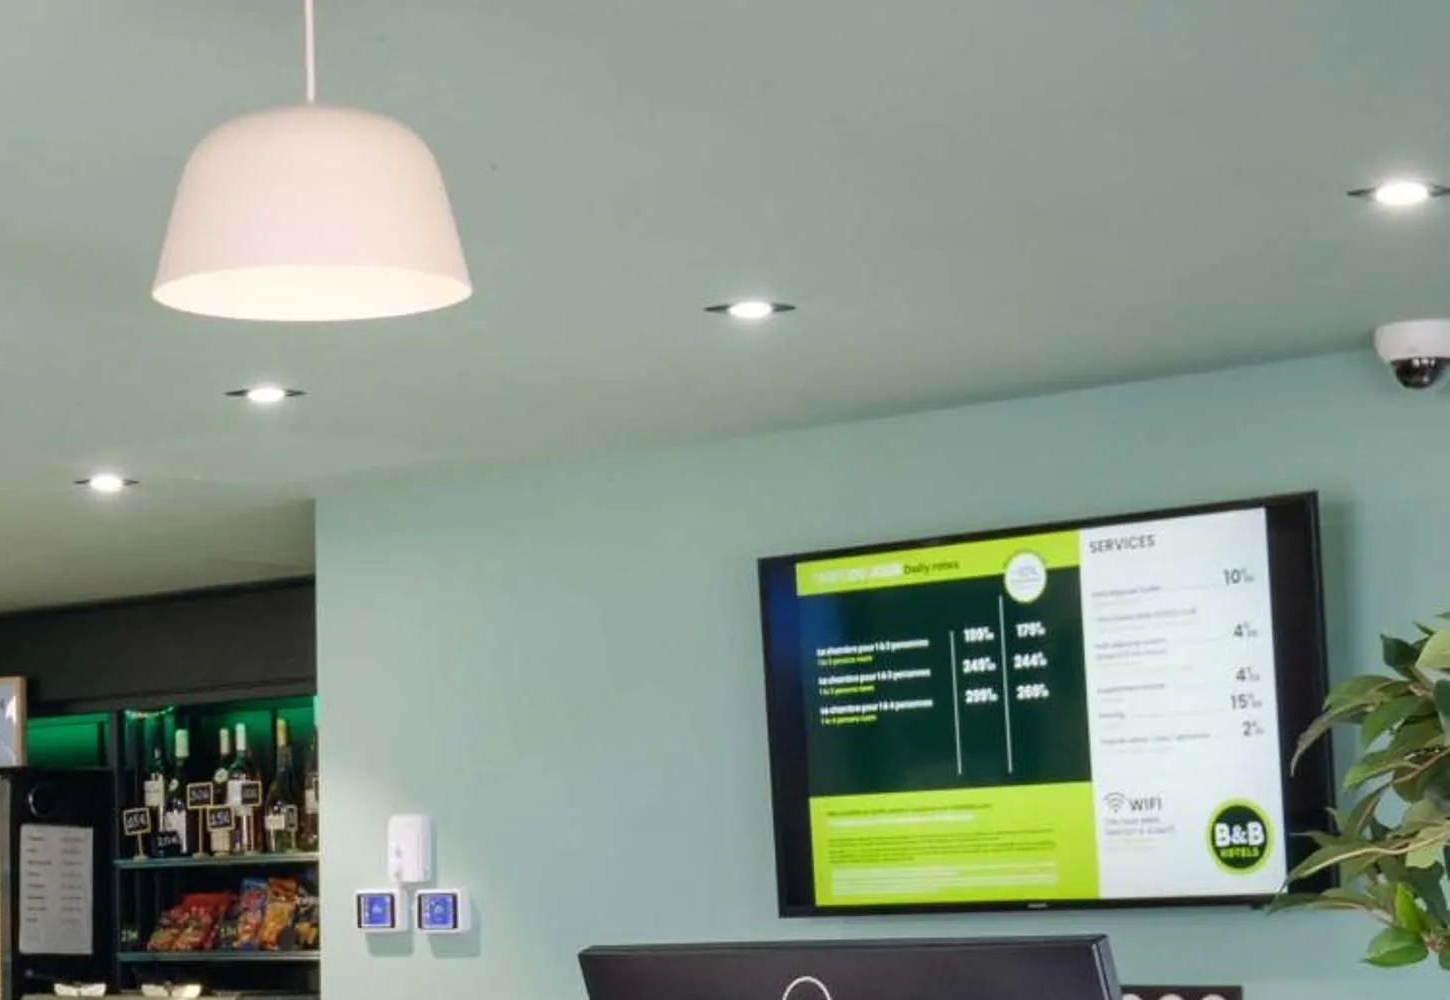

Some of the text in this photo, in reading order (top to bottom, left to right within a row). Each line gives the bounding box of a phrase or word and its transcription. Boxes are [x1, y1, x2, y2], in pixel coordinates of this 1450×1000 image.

[1089, 534, 1156, 553] SERVICES
[903, 563, 931, 575] Daily
[1128, 797, 1163, 811] WIFI
[1215, 821, 1265, 847] B&B
